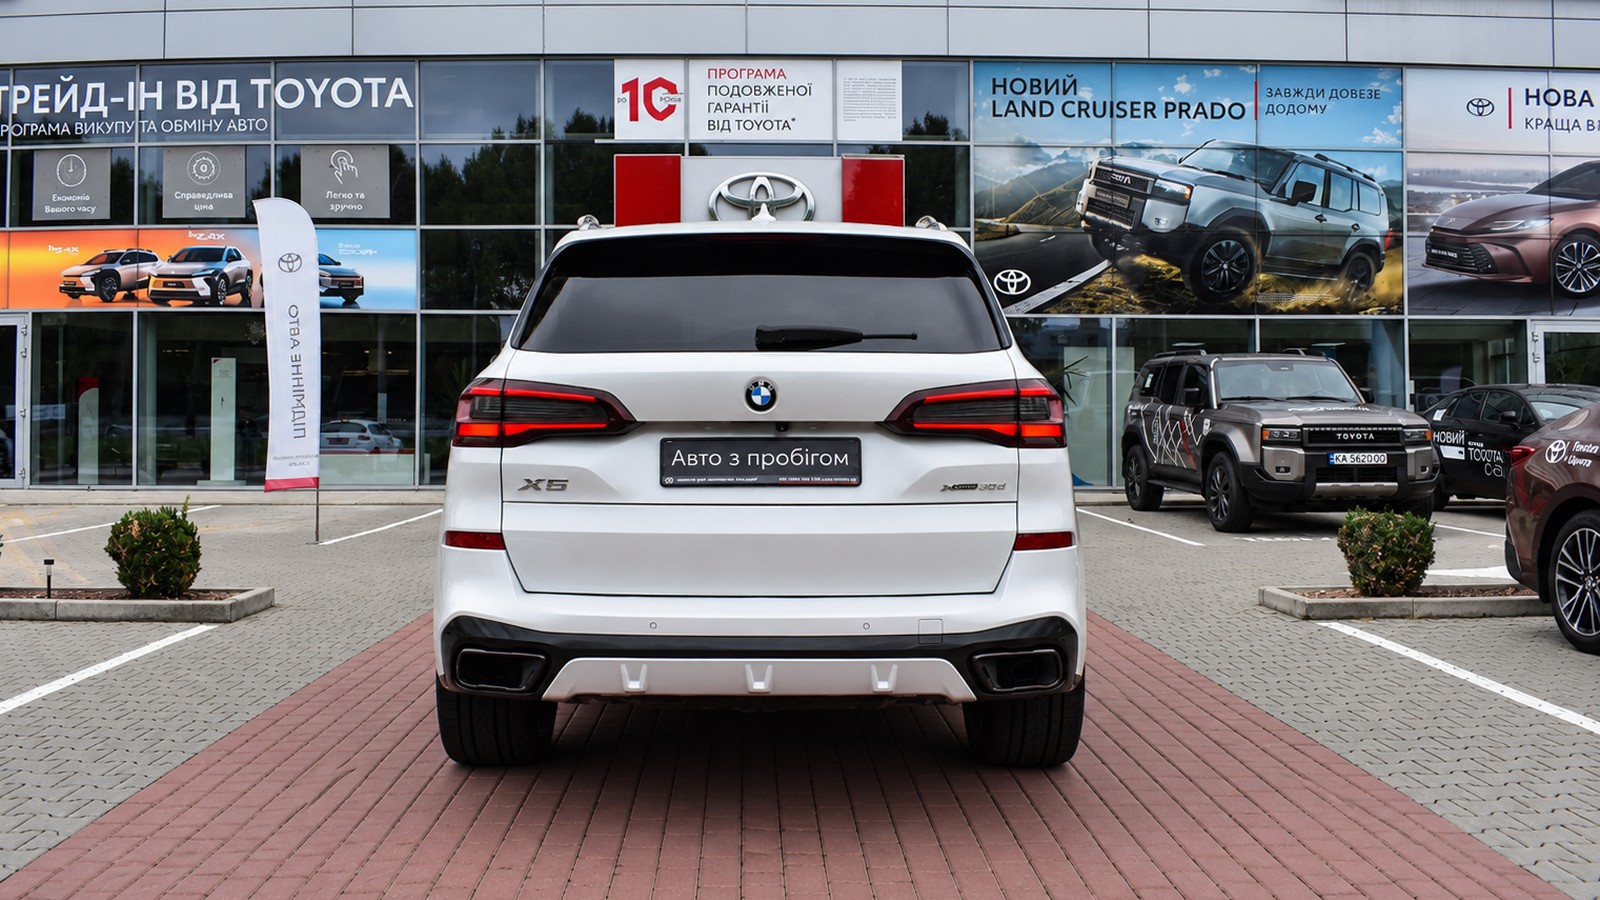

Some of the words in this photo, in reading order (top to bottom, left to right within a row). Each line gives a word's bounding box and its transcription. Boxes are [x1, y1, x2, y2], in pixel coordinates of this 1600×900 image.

[707, 68, 787, 79] ПРОГРАМА
[707, 83, 812, 98] ПОДОВЖЕНОЇ
[991, 74, 1078, 95] НОВИЙ
[176, 78, 241, 116] ВІД
[250, 77, 414, 110] TOYOTA
[1266, 87, 1325, 100] ЗАВЖДИ
[1328, 88, 1381, 100] ДОВЕЗЕ
[1525, 88, 1594, 107] НОВА
[991, 100, 1055, 118] LAND
[1061, 100, 1157, 119] CRUISER
[1164, 101, 1246, 120] PRADO
[1265, 104, 1327, 115] ДОДОМУ
[75, 120, 135, 135] ВИКУПУ
[140, 120, 158, 133] ТА
[160, 118, 224, 133] ОБМІНУ
[226, 118, 268, 132] АВТО
[707, 119, 731, 133] ВІД
[1525, 118, 1582, 133] КРАЩА
[1433, 430, 1465, 445] НОВИЙ
[671, 449, 722, 466] Авто
[729, 453, 740, 466] з
[747, 447, 849, 470] пробігом
[517, 478, 569, 491] X5
